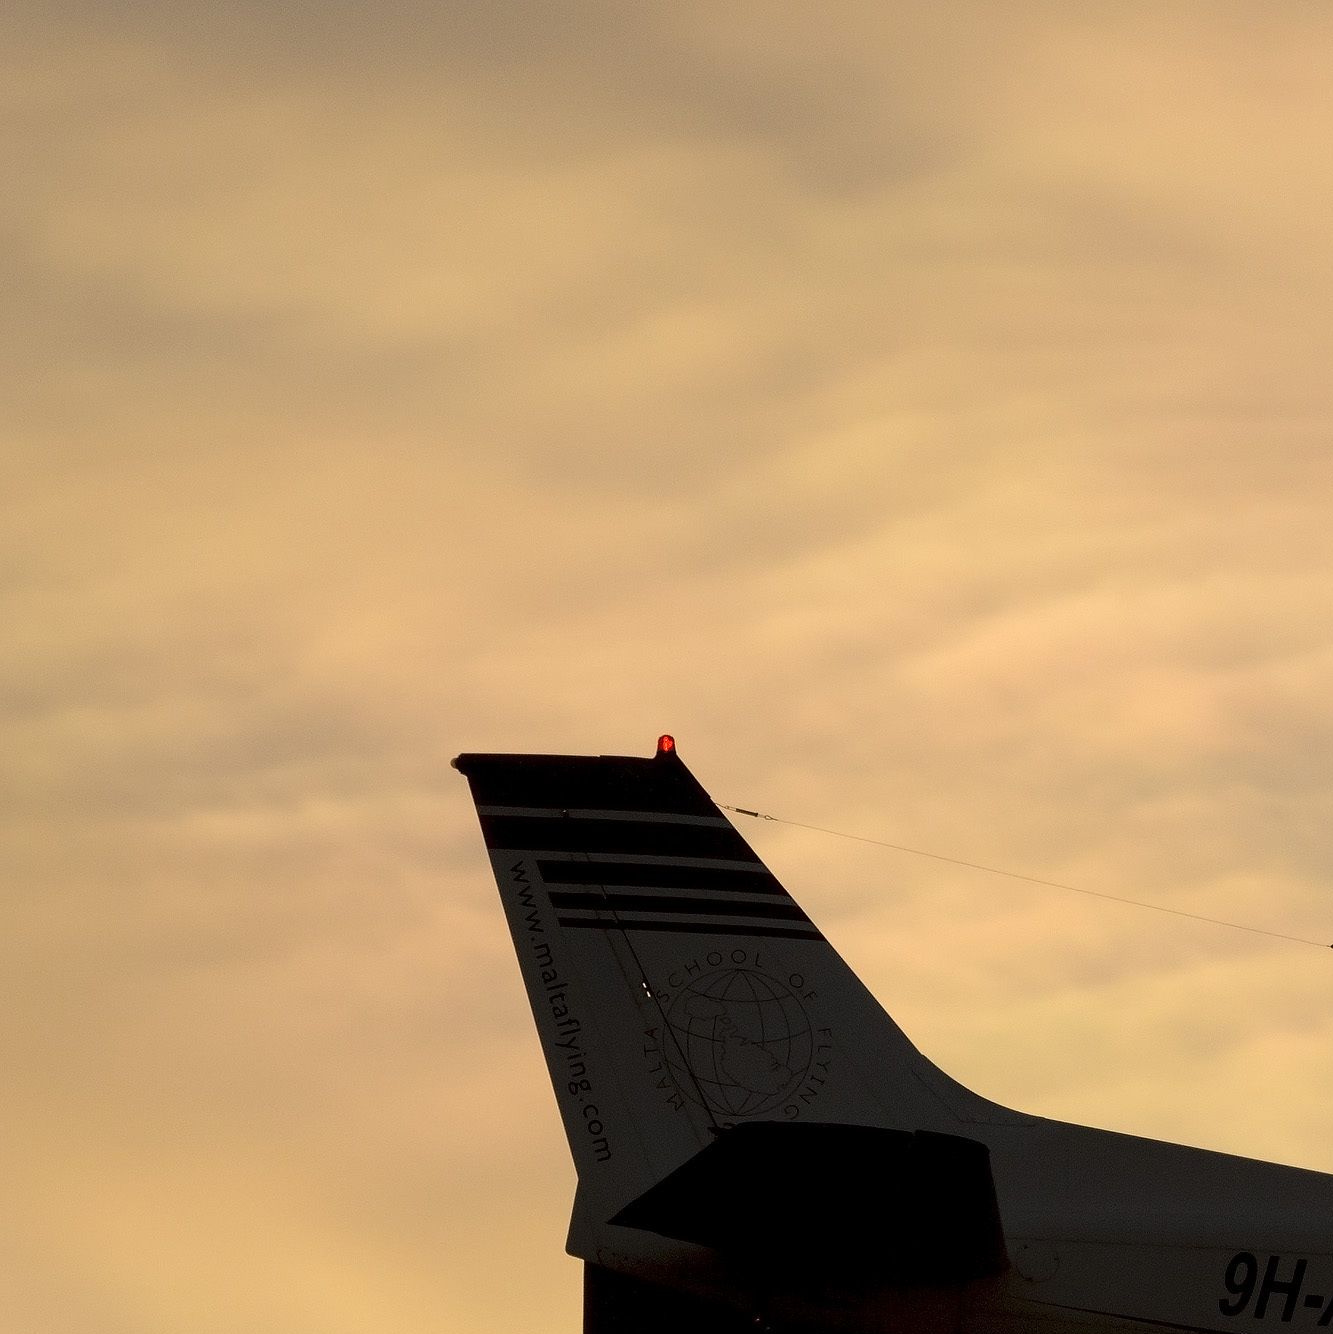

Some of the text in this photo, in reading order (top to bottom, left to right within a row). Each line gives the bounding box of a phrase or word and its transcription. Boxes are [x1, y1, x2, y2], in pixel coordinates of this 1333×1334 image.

[510, 860, 612, 1163] www.maltaflying.com
[643, 949, 833, 1120] MALTA SCHOOL OF FLYING
